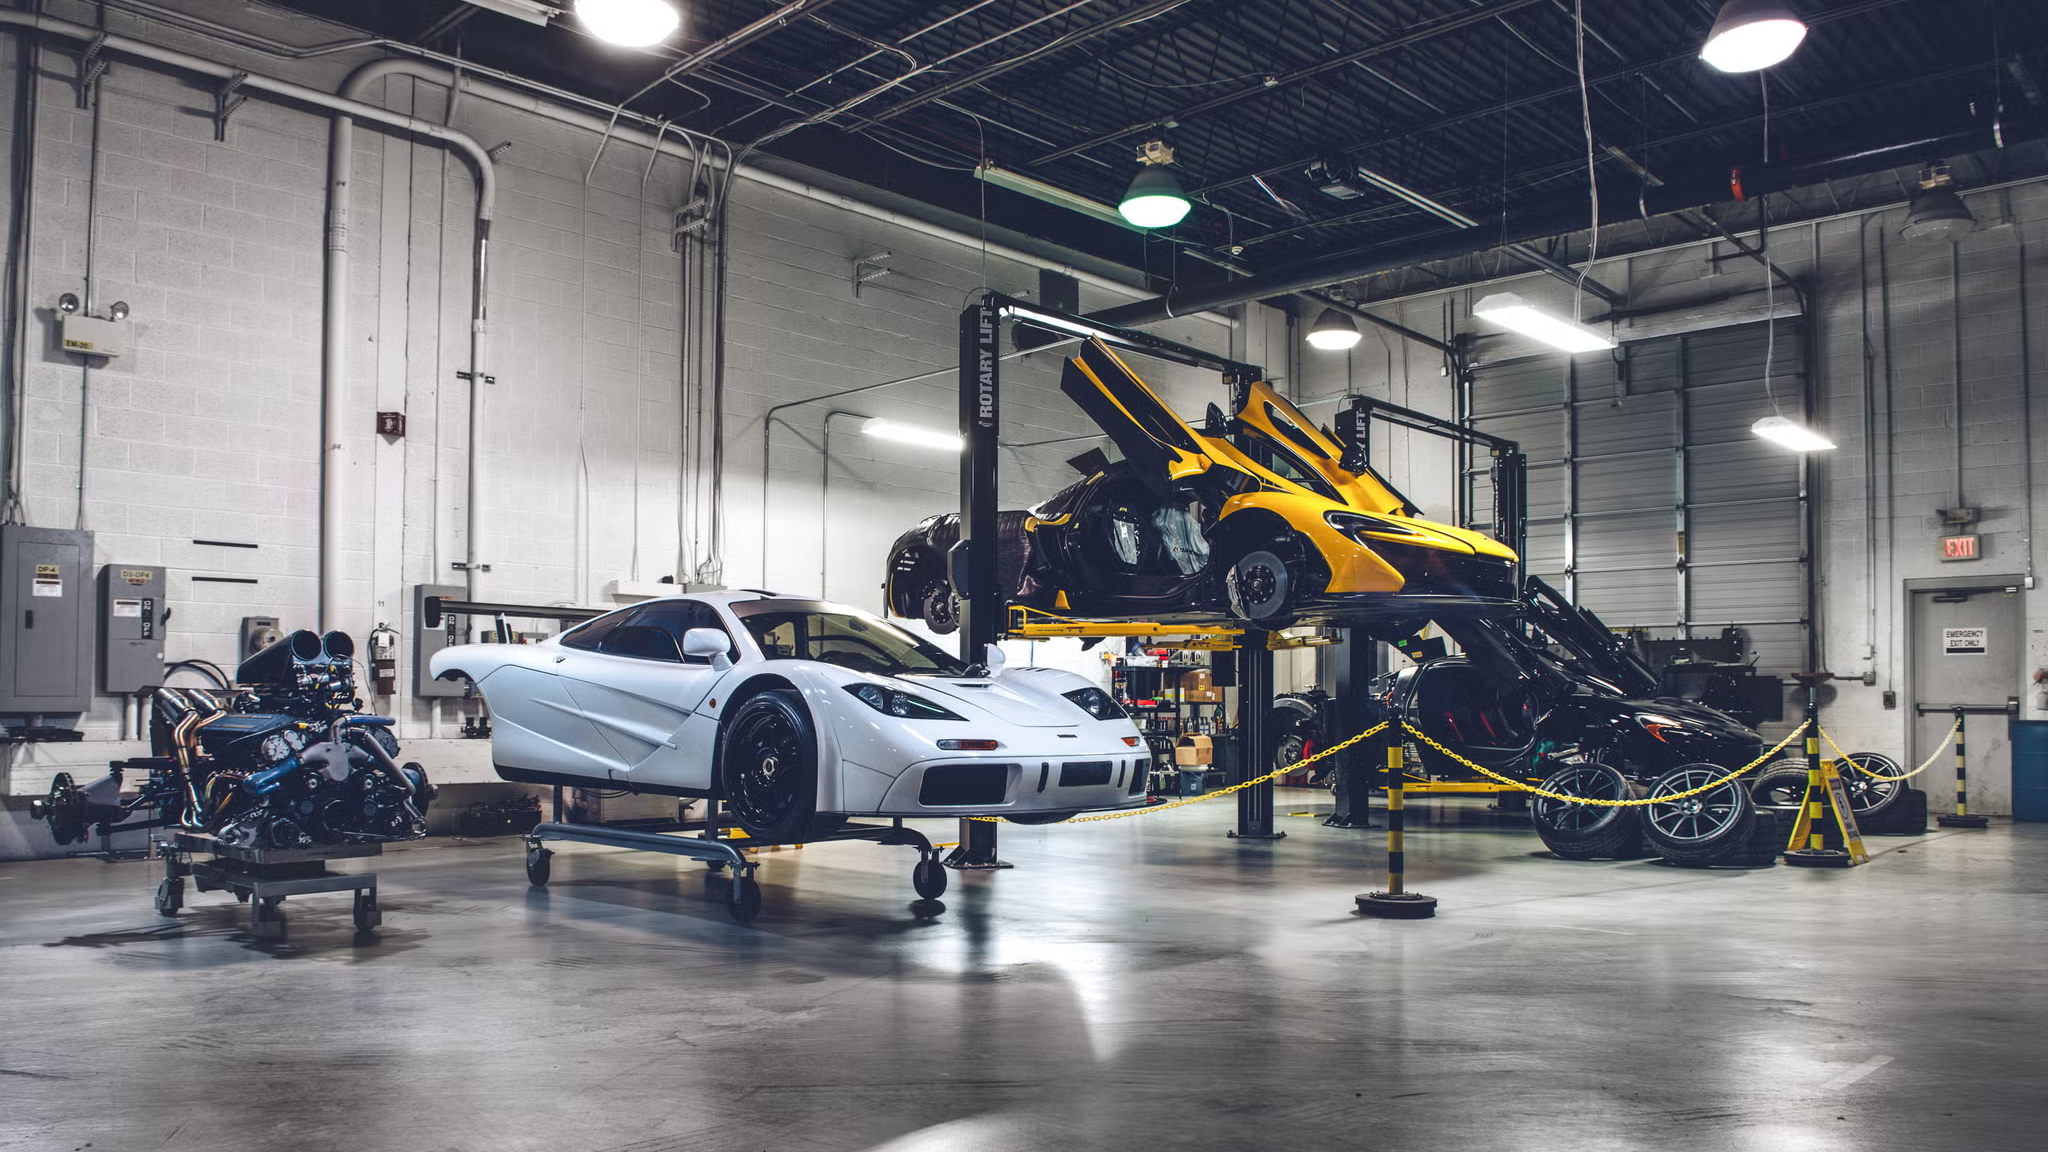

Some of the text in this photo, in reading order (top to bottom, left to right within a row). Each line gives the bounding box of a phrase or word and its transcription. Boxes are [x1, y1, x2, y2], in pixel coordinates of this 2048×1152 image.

[980, 307, 993, 343] LIFT
[979, 348, 993, 417] ROTARY
[1356, 411, 1366, 438] LIFT
[1945, 538, 1974, 557] EXIT
[143, 600, 151, 611] ON
[143, 621, 151, 637] OFF
[448, 616, 455, 625] ON
[1946, 630, 1983, 638] EMERGENCY
